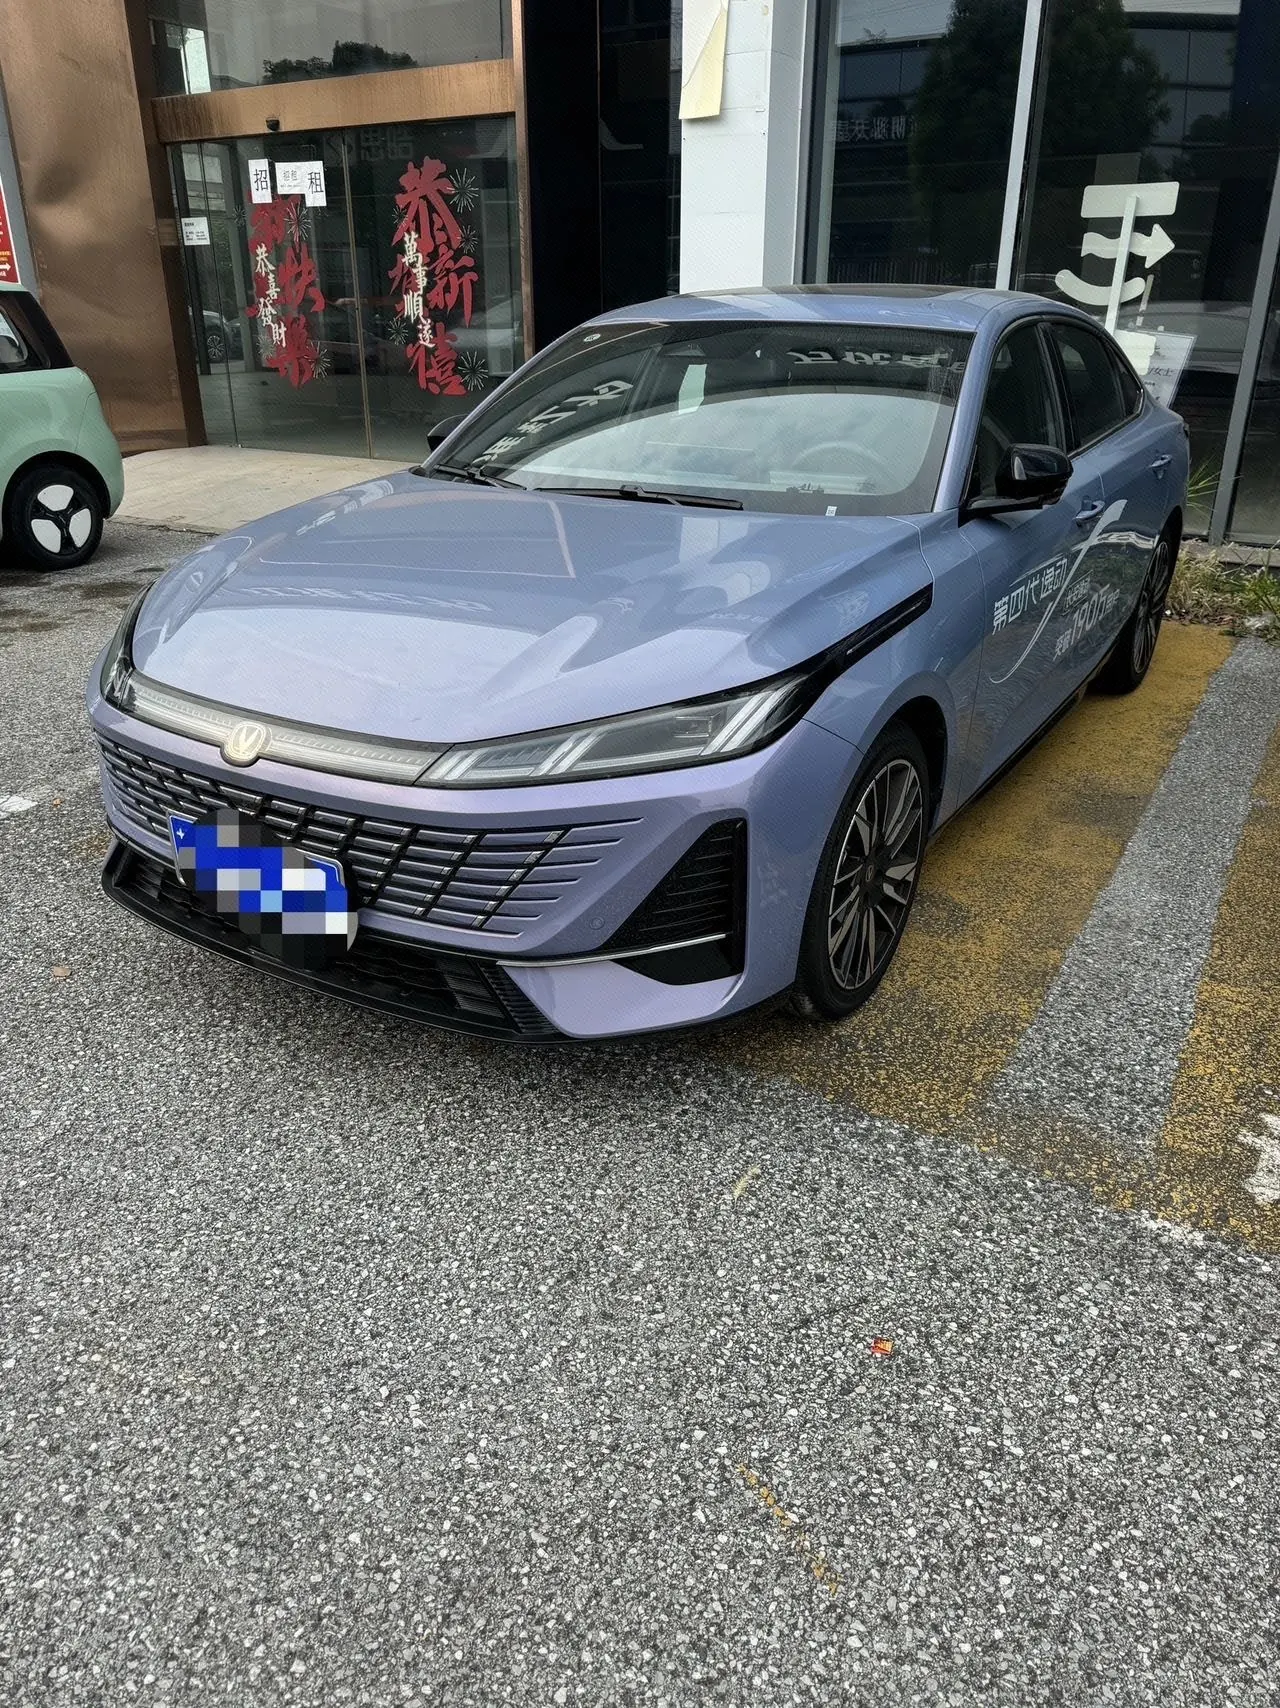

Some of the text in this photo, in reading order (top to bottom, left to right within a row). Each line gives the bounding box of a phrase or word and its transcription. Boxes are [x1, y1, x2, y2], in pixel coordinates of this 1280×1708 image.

[253, 169, 324, 195] 招 租
[255, 243, 287, 348] 恭喜發財
[992, 558, 1067, 635] 第四代逸动
